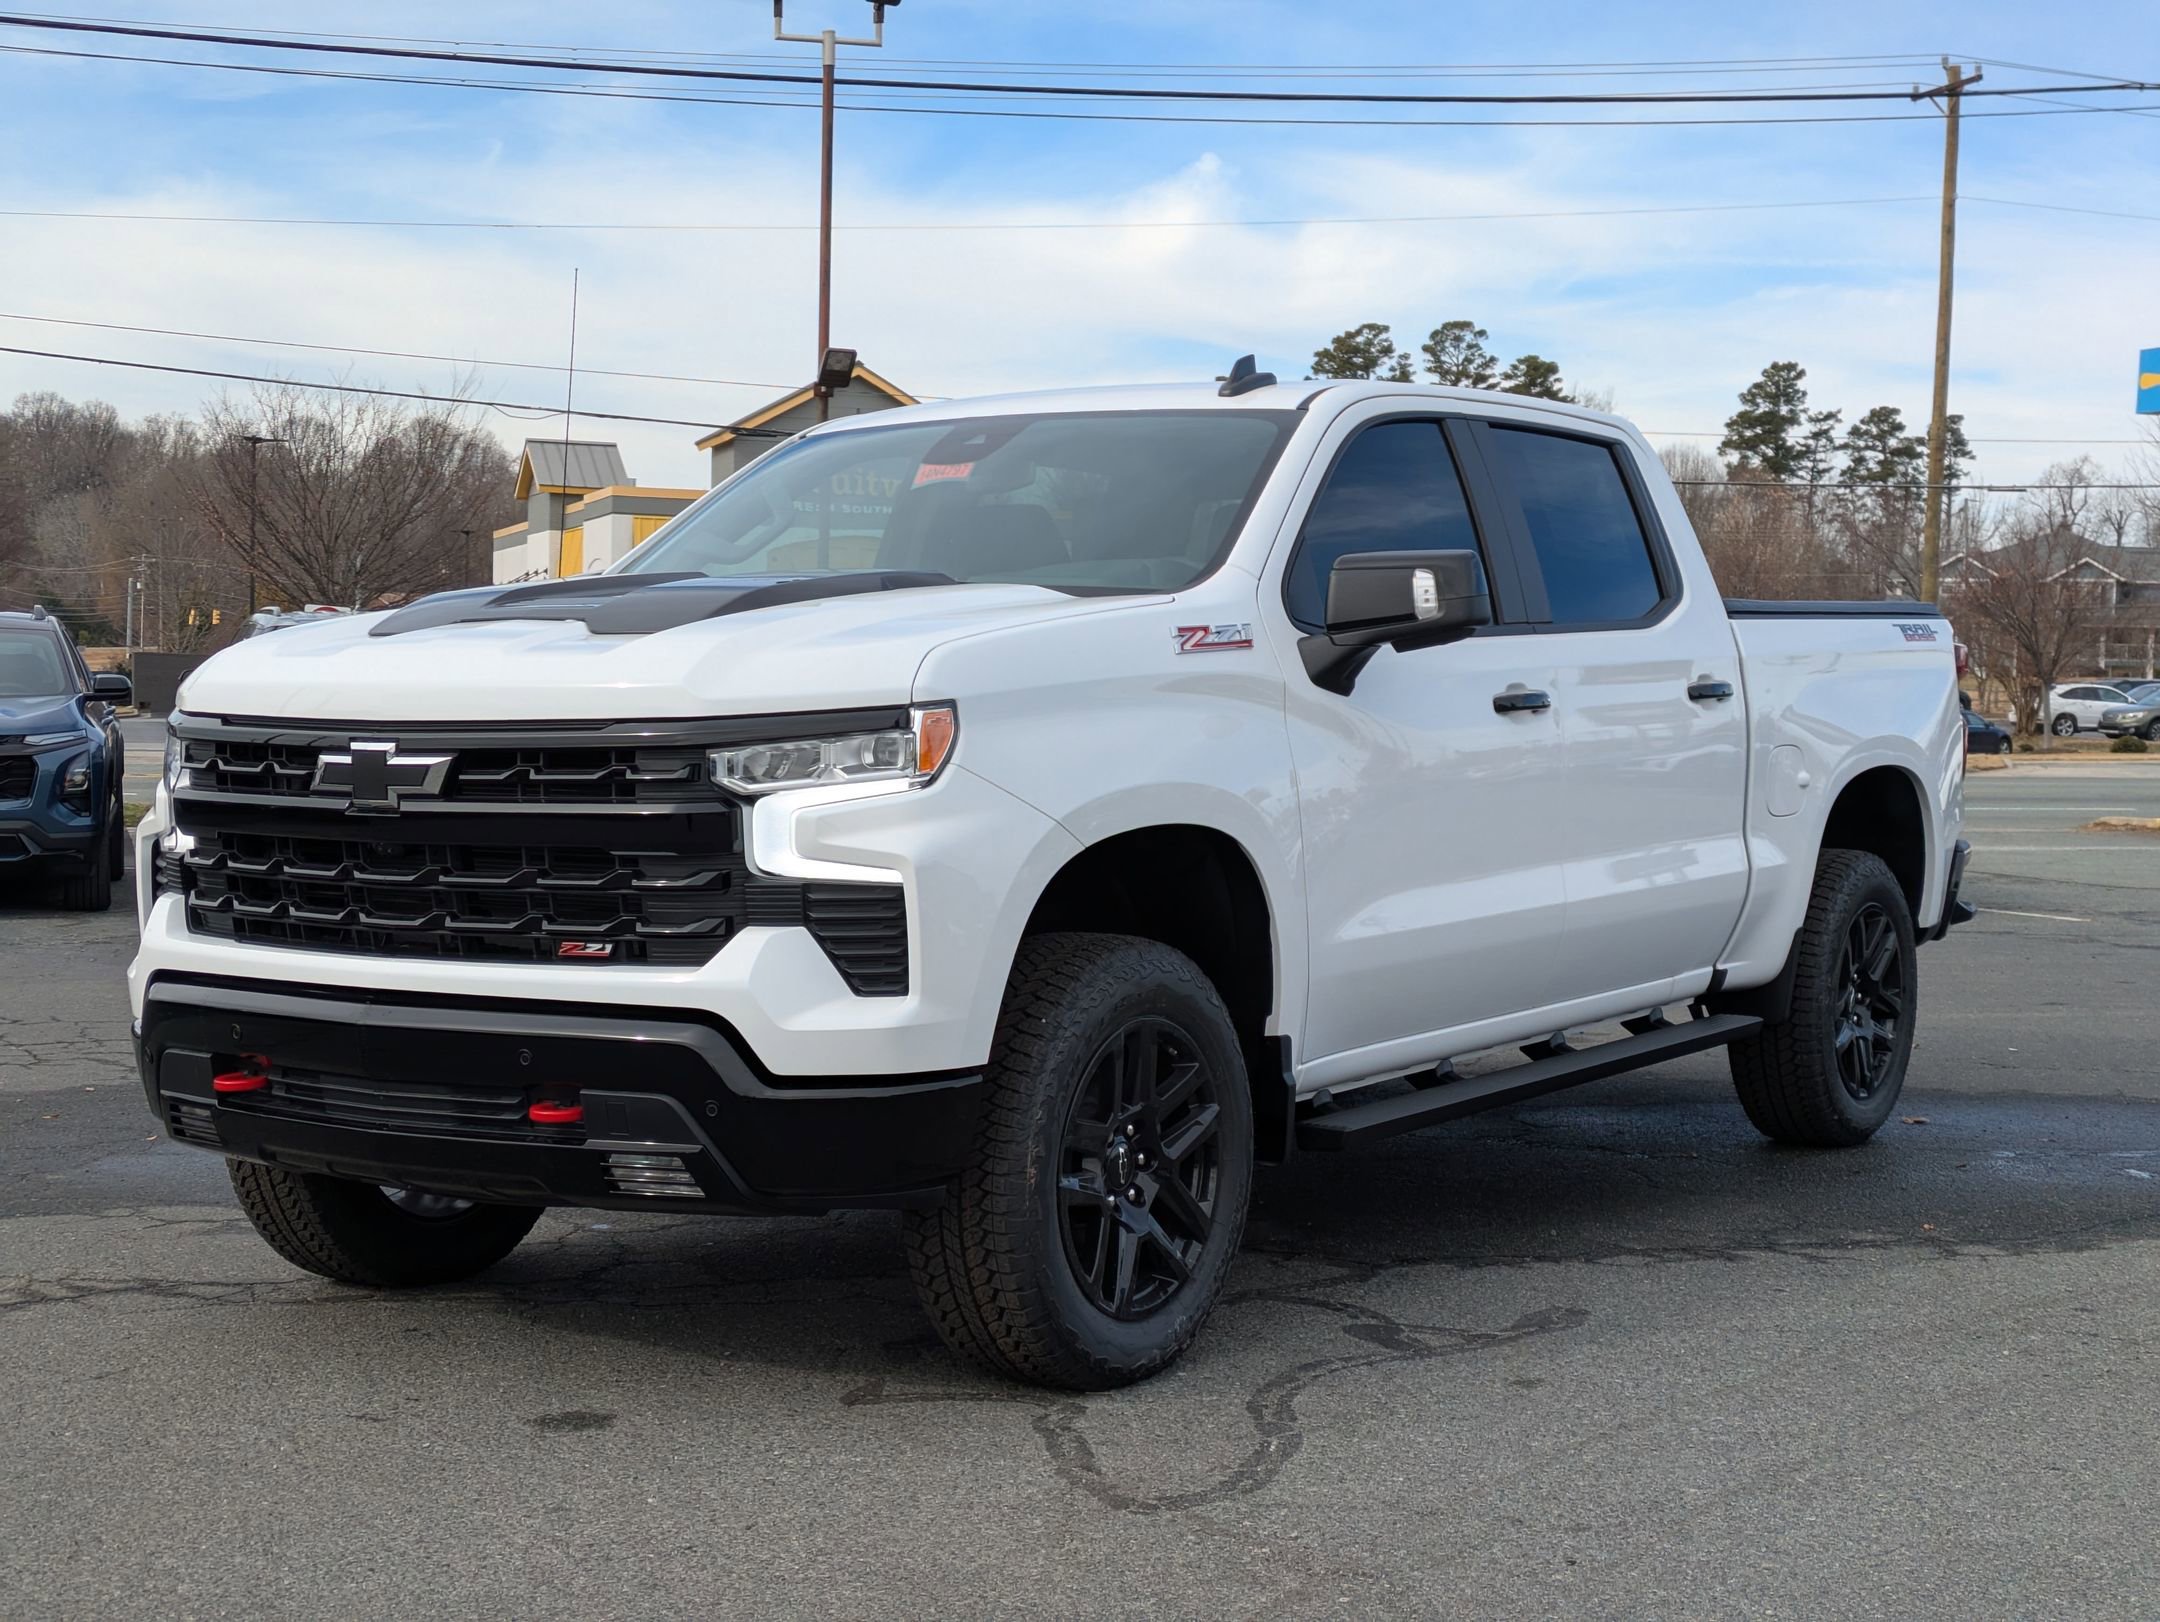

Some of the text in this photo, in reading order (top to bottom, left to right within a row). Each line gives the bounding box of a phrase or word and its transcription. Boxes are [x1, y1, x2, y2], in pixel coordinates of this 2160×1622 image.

[1891, 623, 1939, 635] TRAIL
[1170, 622, 1254, 655] Z71
[1904, 633, 1937, 642] BOSS
[558, 941, 613, 957] Z71
